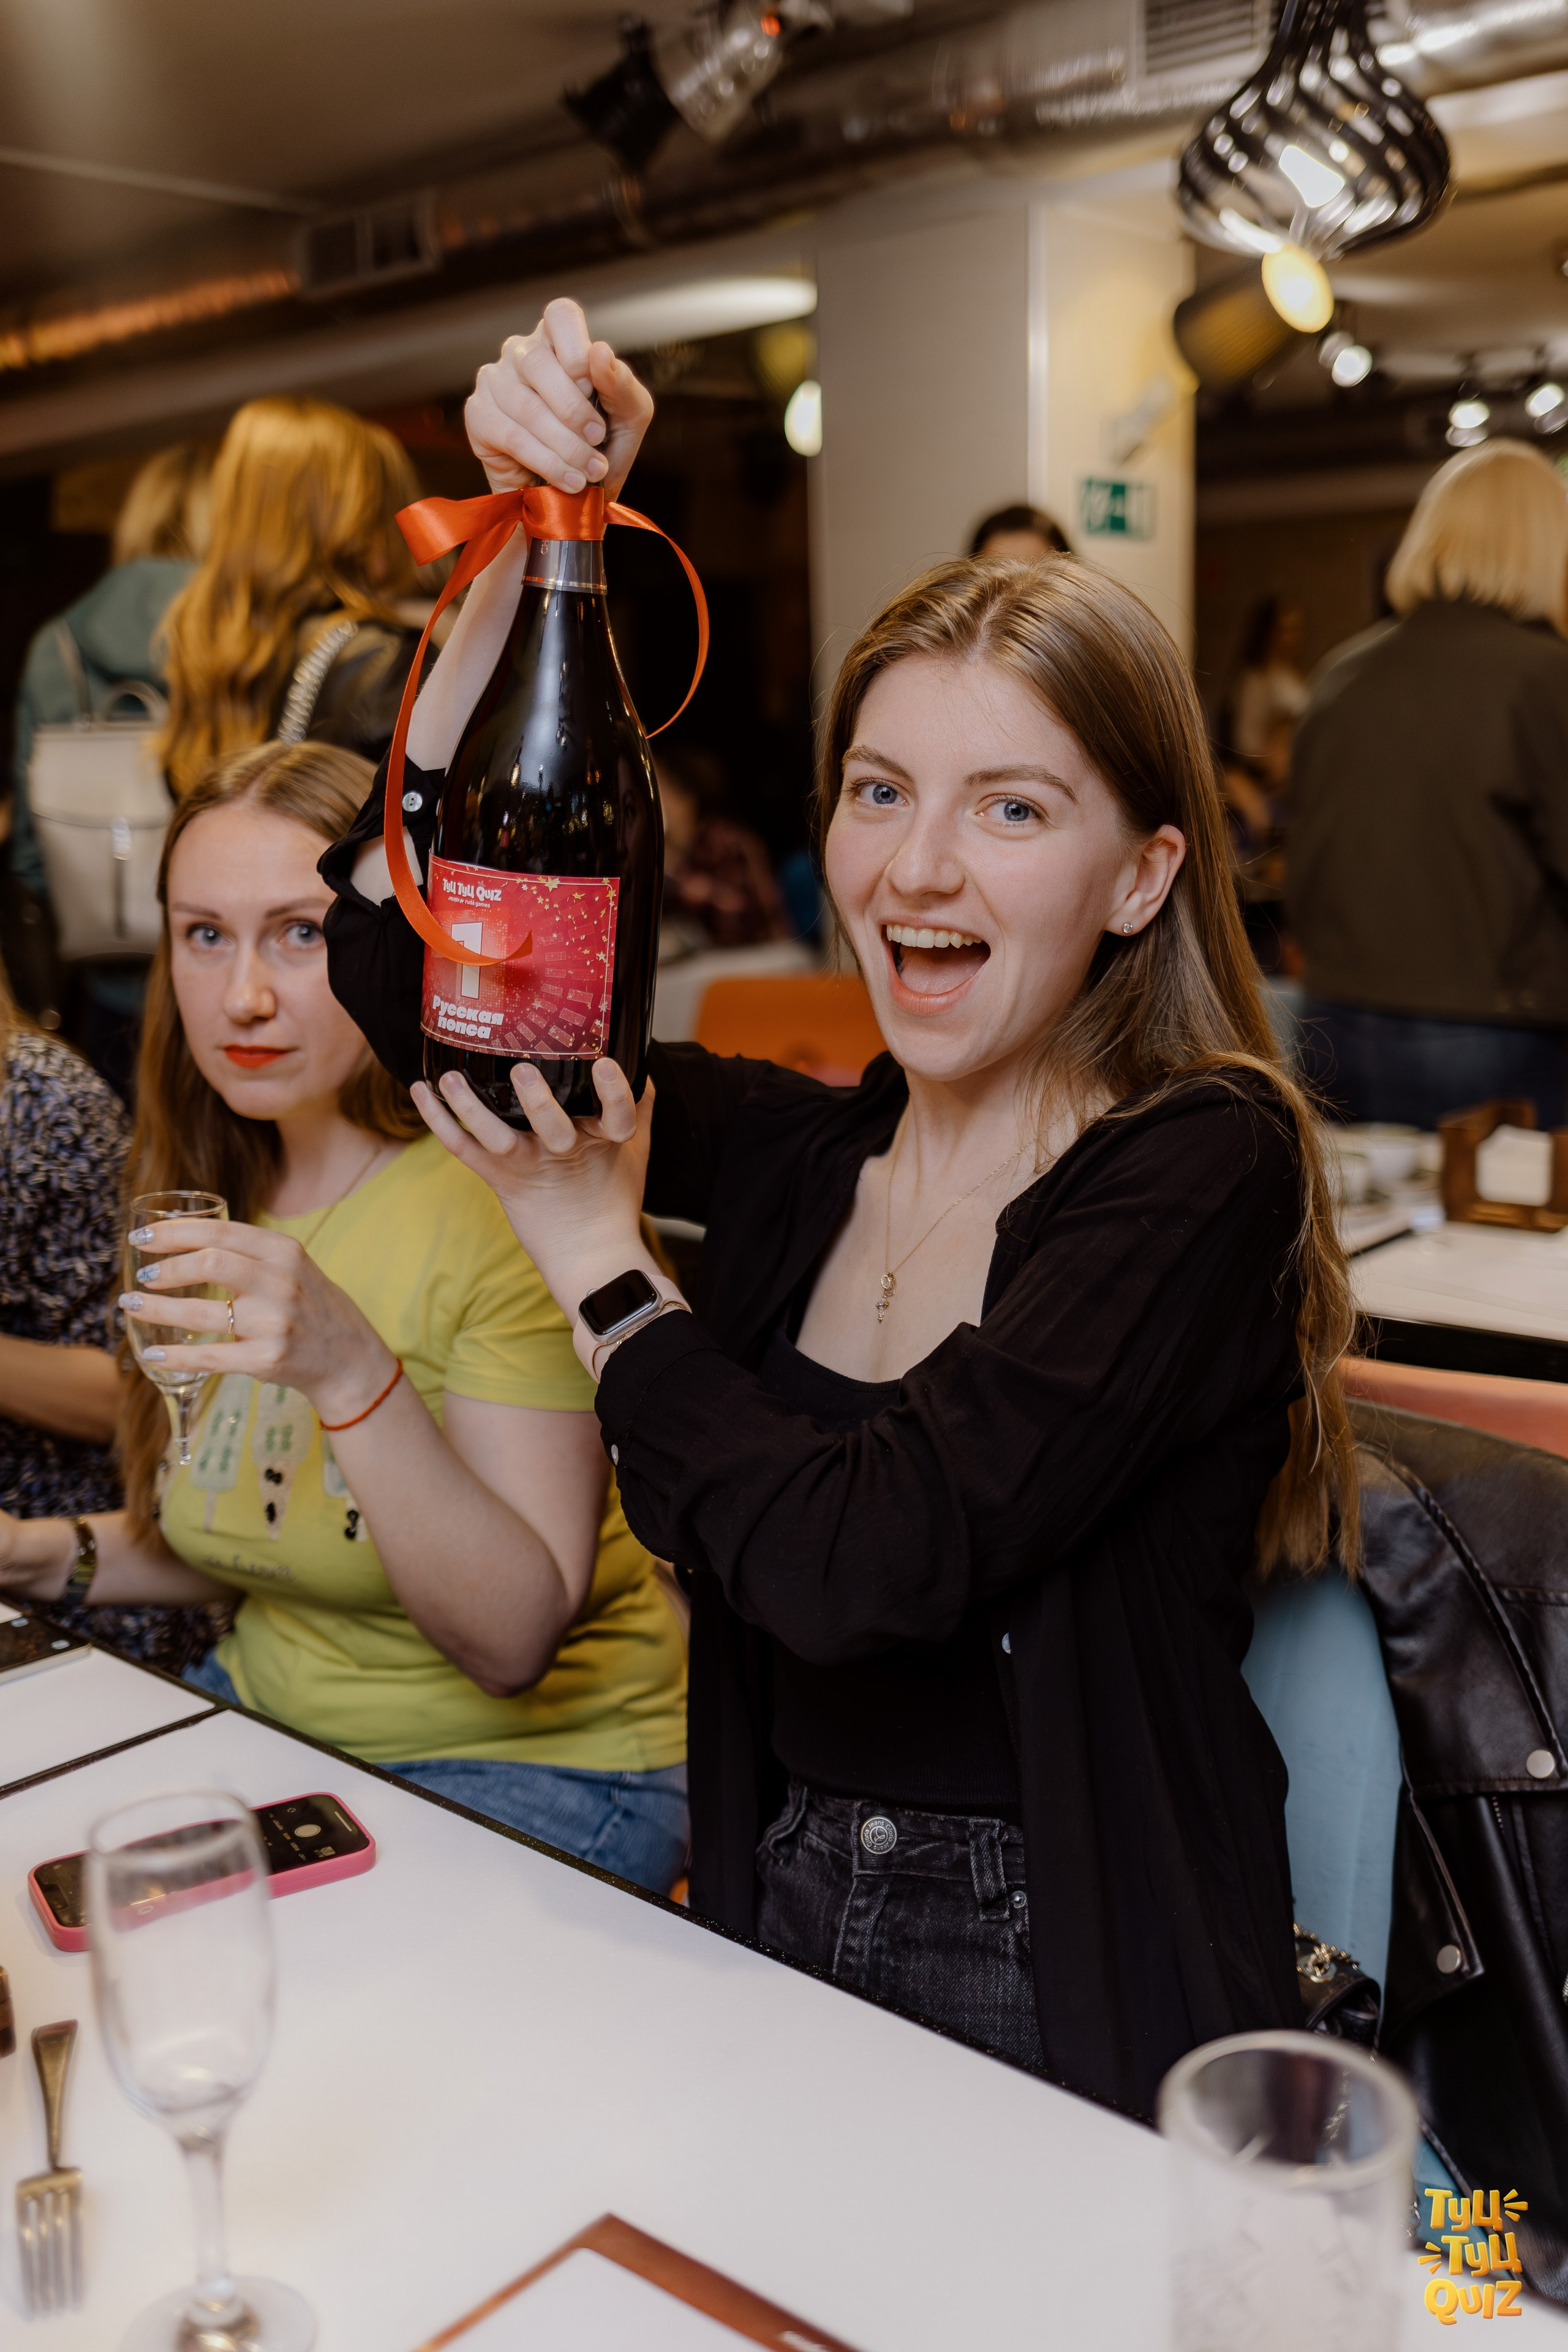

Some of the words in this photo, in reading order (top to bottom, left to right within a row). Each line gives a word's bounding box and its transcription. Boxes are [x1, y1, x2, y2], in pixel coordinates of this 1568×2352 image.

[451, 922, 483, 1000] 1
[437, 1016, 491, 1039] попса
[868, 1821, 884, 1830] Jeans
